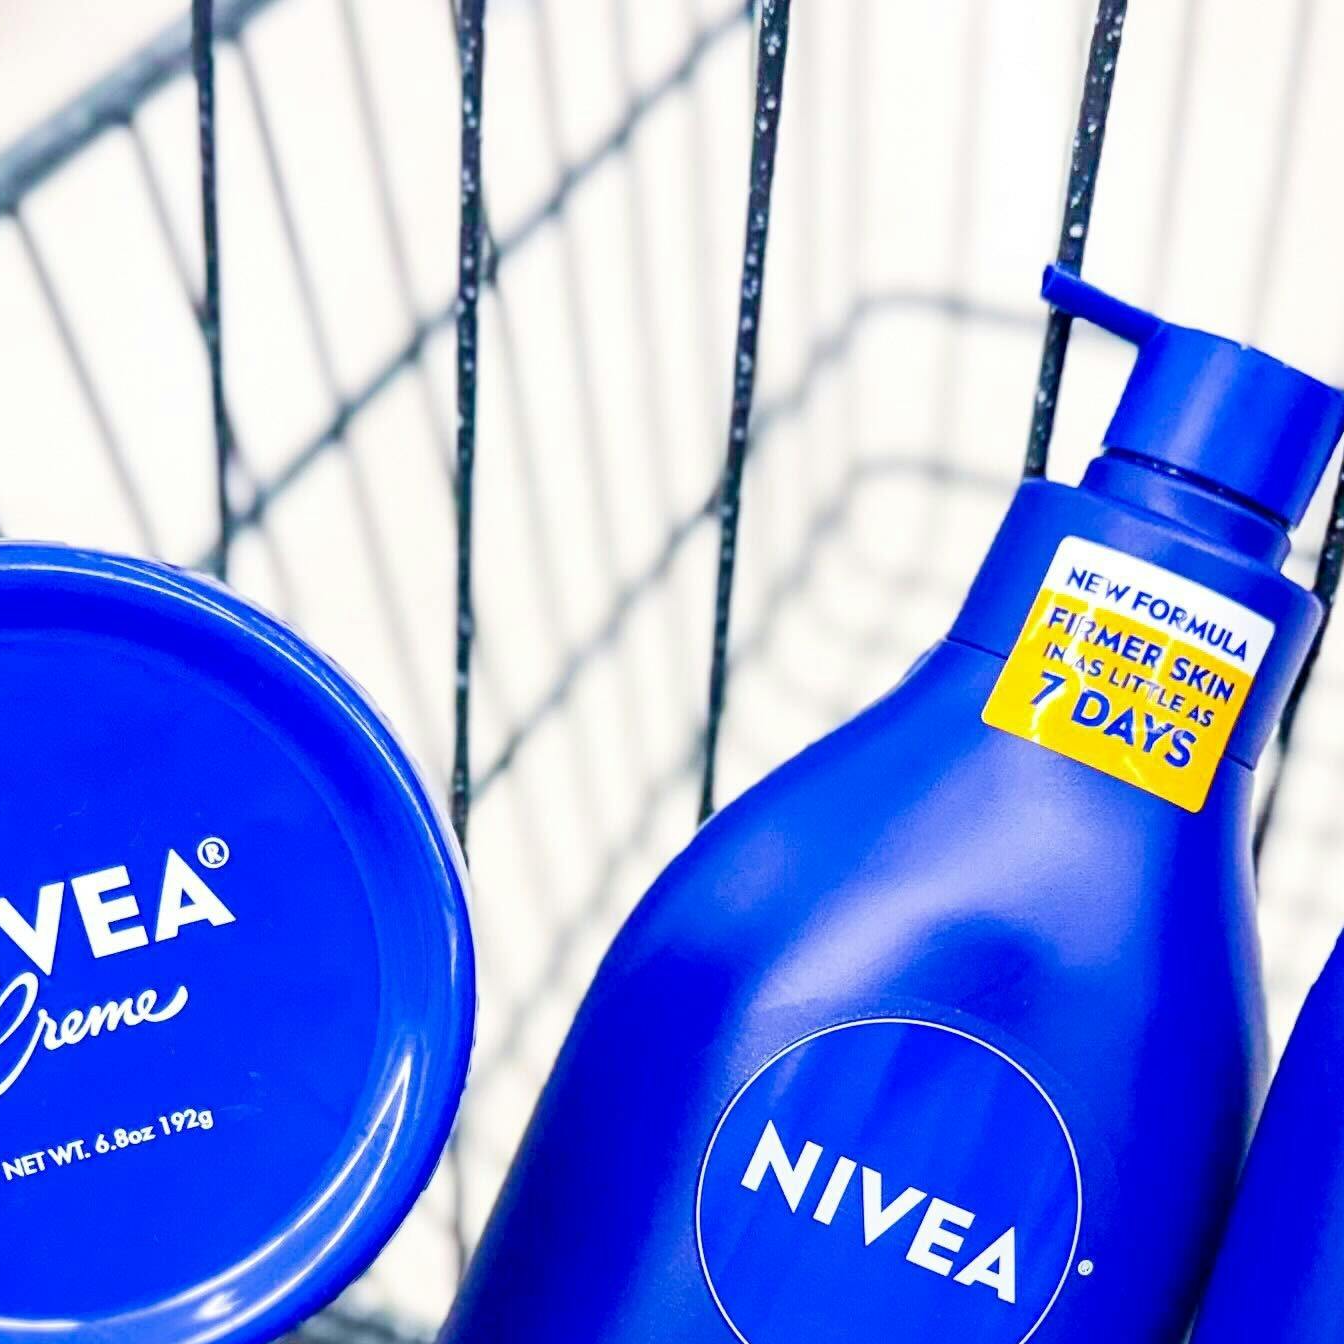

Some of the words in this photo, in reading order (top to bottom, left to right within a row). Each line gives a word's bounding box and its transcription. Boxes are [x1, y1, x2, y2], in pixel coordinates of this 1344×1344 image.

[1047, 607, 1163, 668] FIRMER
[1170, 657, 1235, 705] SKIN
[1066, 566, 1130, 602] NEW
[1131, 592, 1248, 662] FORMULA
[1029, 671, 1067, 706] 7
[1071, 689, 1197, 768] DAYS
[1043, 642, 1067, 663] IN
[1075, 655, 1104, 677] AS
[1108, 667, 1185, 713] LITTLE
[1187, 703, 1214, 728] AS
[2, 1152, 45, 1181] NET
[48, 1140, 91, 1166] WT.
[95, 1124, 156, 1154] 6.8oz
[159, 1109, 213, 1136] 192g
[740, 1119, 1016, 1304] NIVEA
